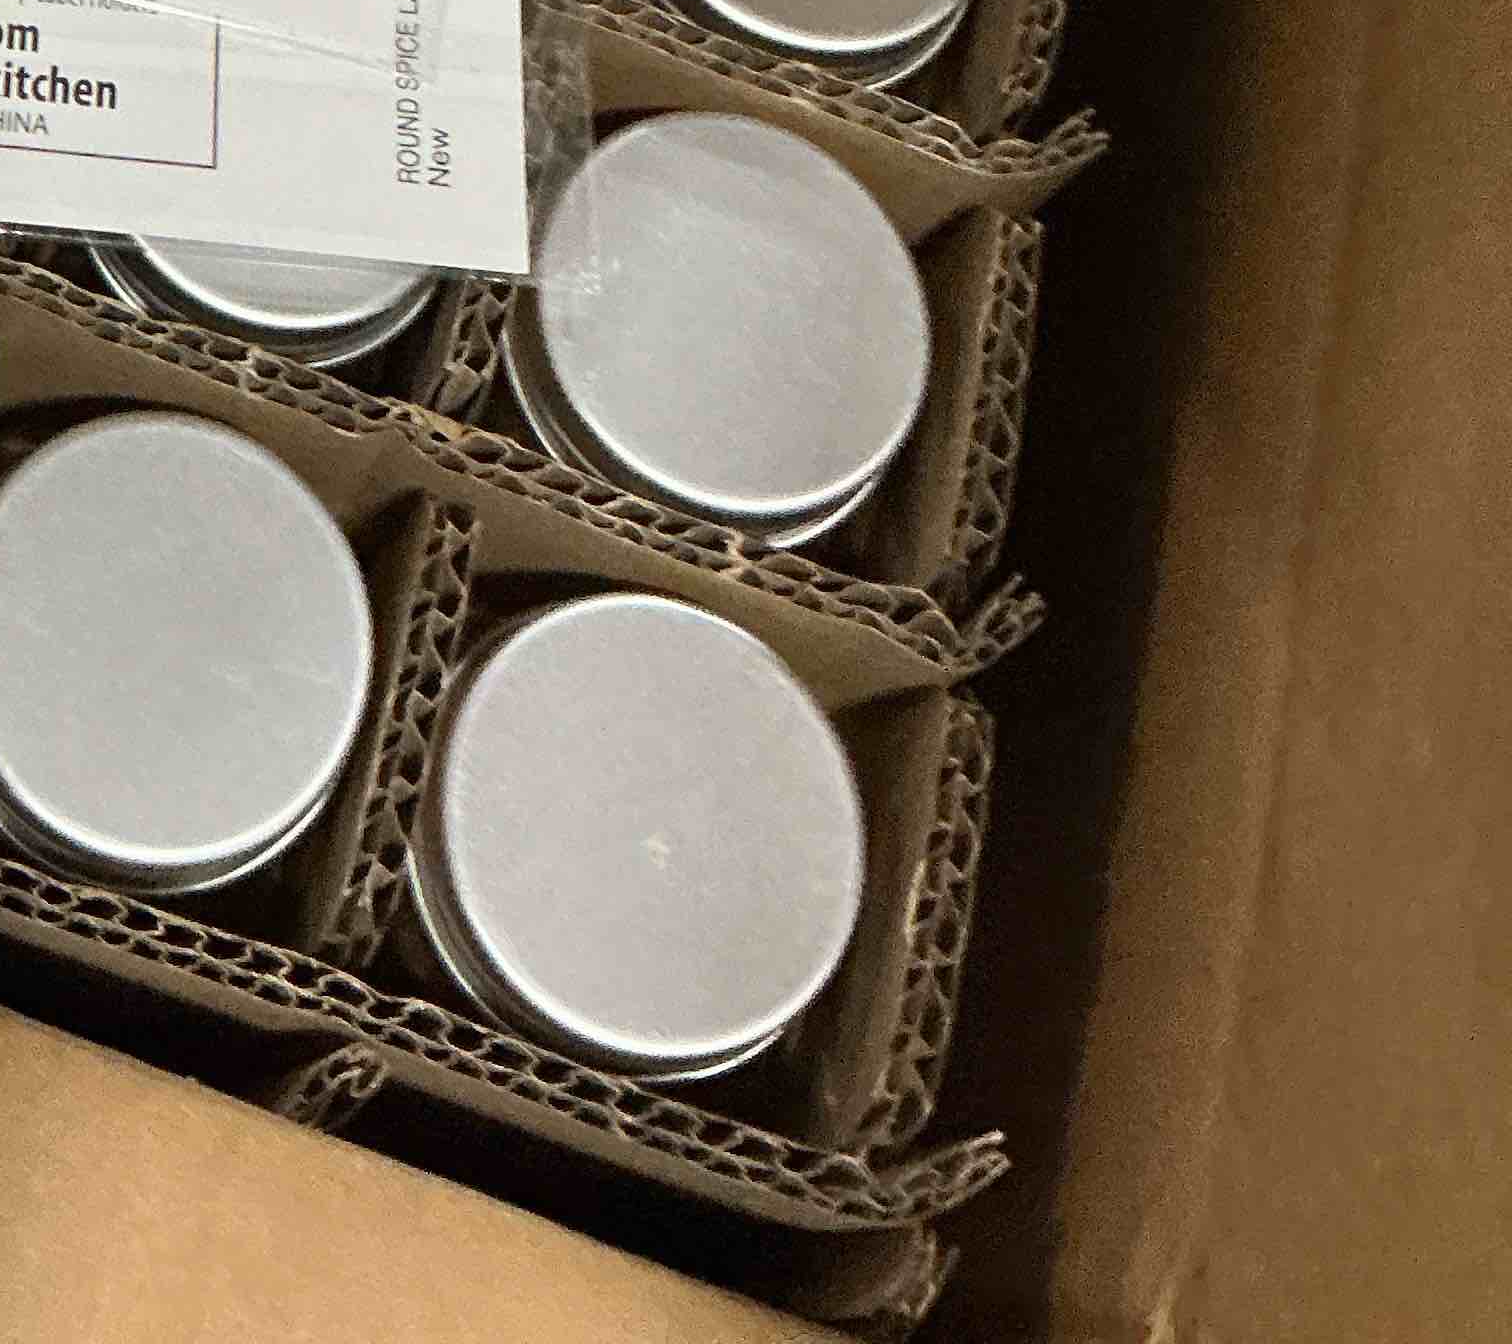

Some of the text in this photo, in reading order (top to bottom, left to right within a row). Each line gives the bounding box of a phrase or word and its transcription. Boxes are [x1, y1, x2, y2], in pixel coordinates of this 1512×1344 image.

[396, 22, 421, 90] SPICE
[396, 97, 421, 184] ROUND
[428, 128, 452, 188] New
